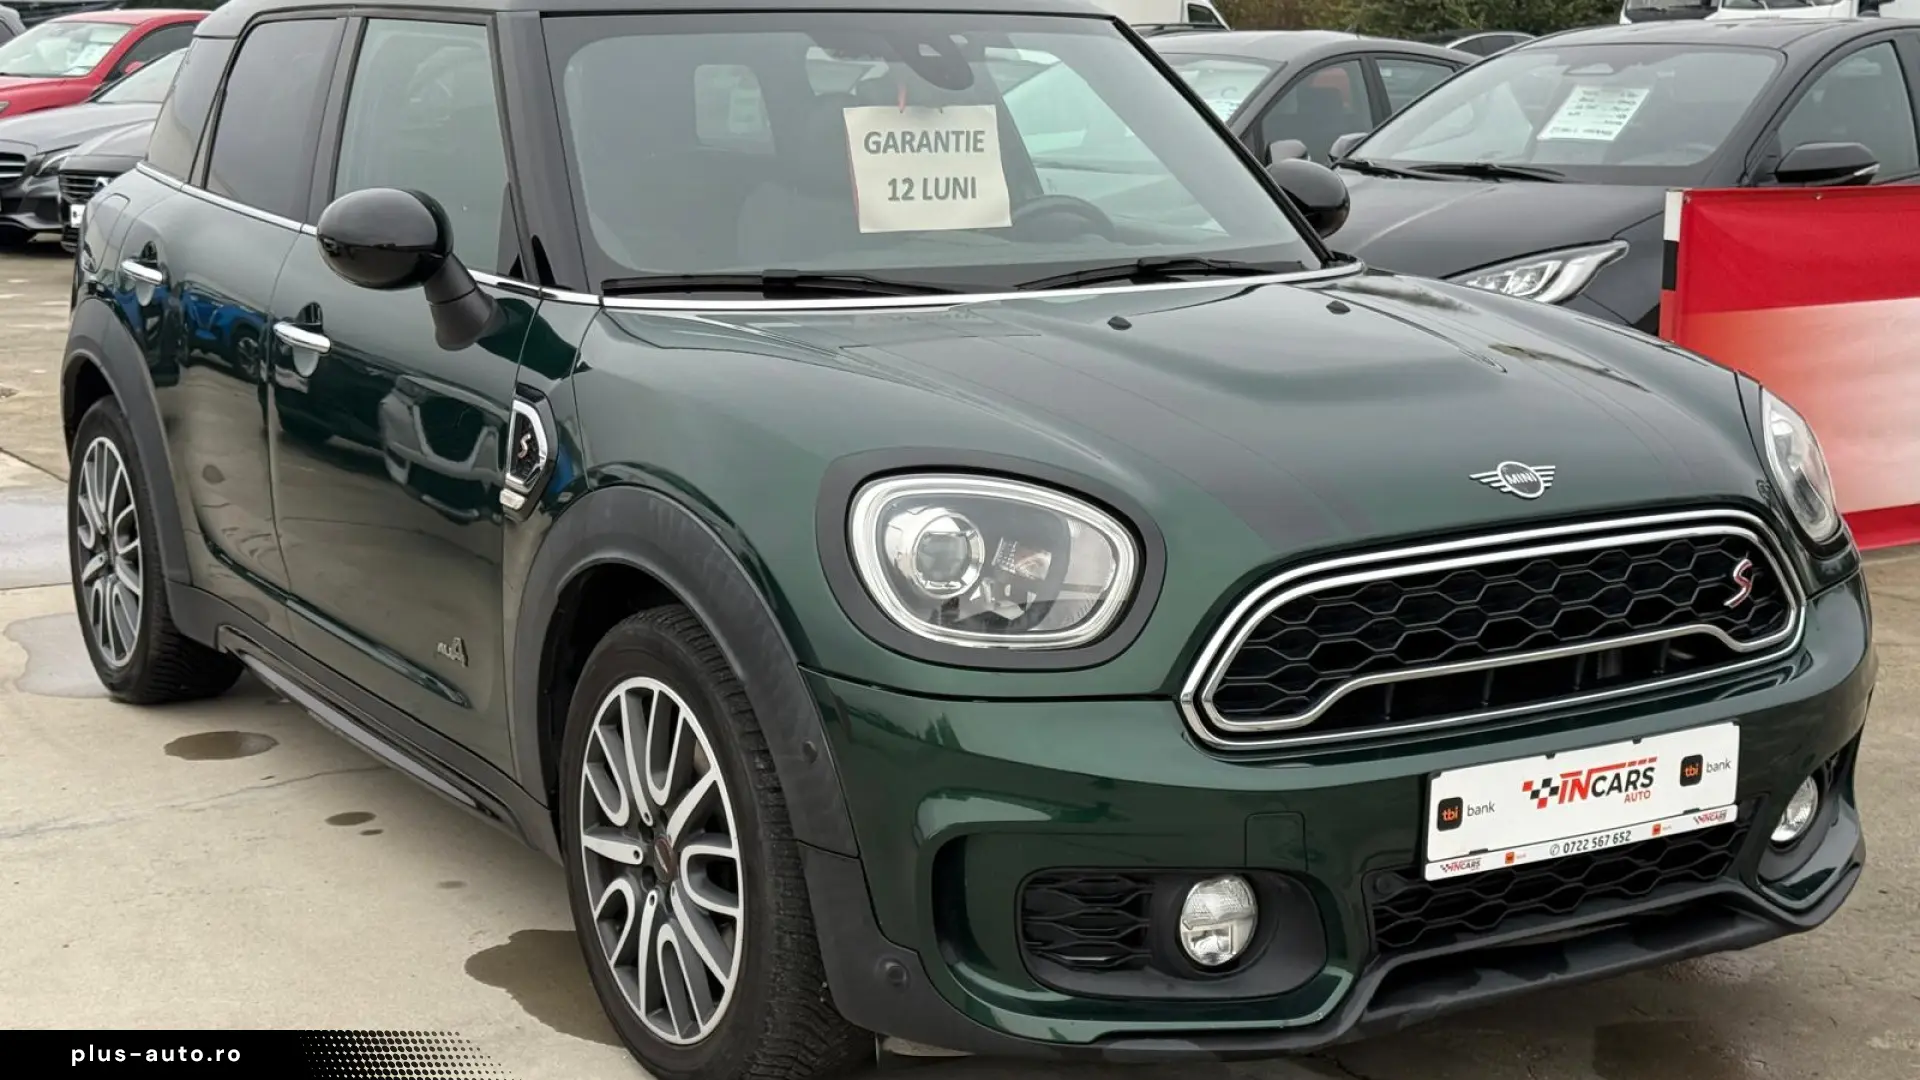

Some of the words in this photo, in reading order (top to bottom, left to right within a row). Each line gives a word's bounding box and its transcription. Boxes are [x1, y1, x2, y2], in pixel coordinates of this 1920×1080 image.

[864, 130, 986, 155] GARANTIE
[887, 177, 915, 201] 12
[922, 176, 977, 201] LUNI
[1504, 472, 1537, 485] MINI
[1706, 758, 1732, 774] bank
[1558, 758, 1657, 804] INCARS
[1624, 790, 1651, 803] AUTO
[1467, 801, 1495, 817] bank
[1563, 838, 1589, 854] 0722
[1592, 834, 1610, 849] 567
[1613, 830, 1632, 844] 652
